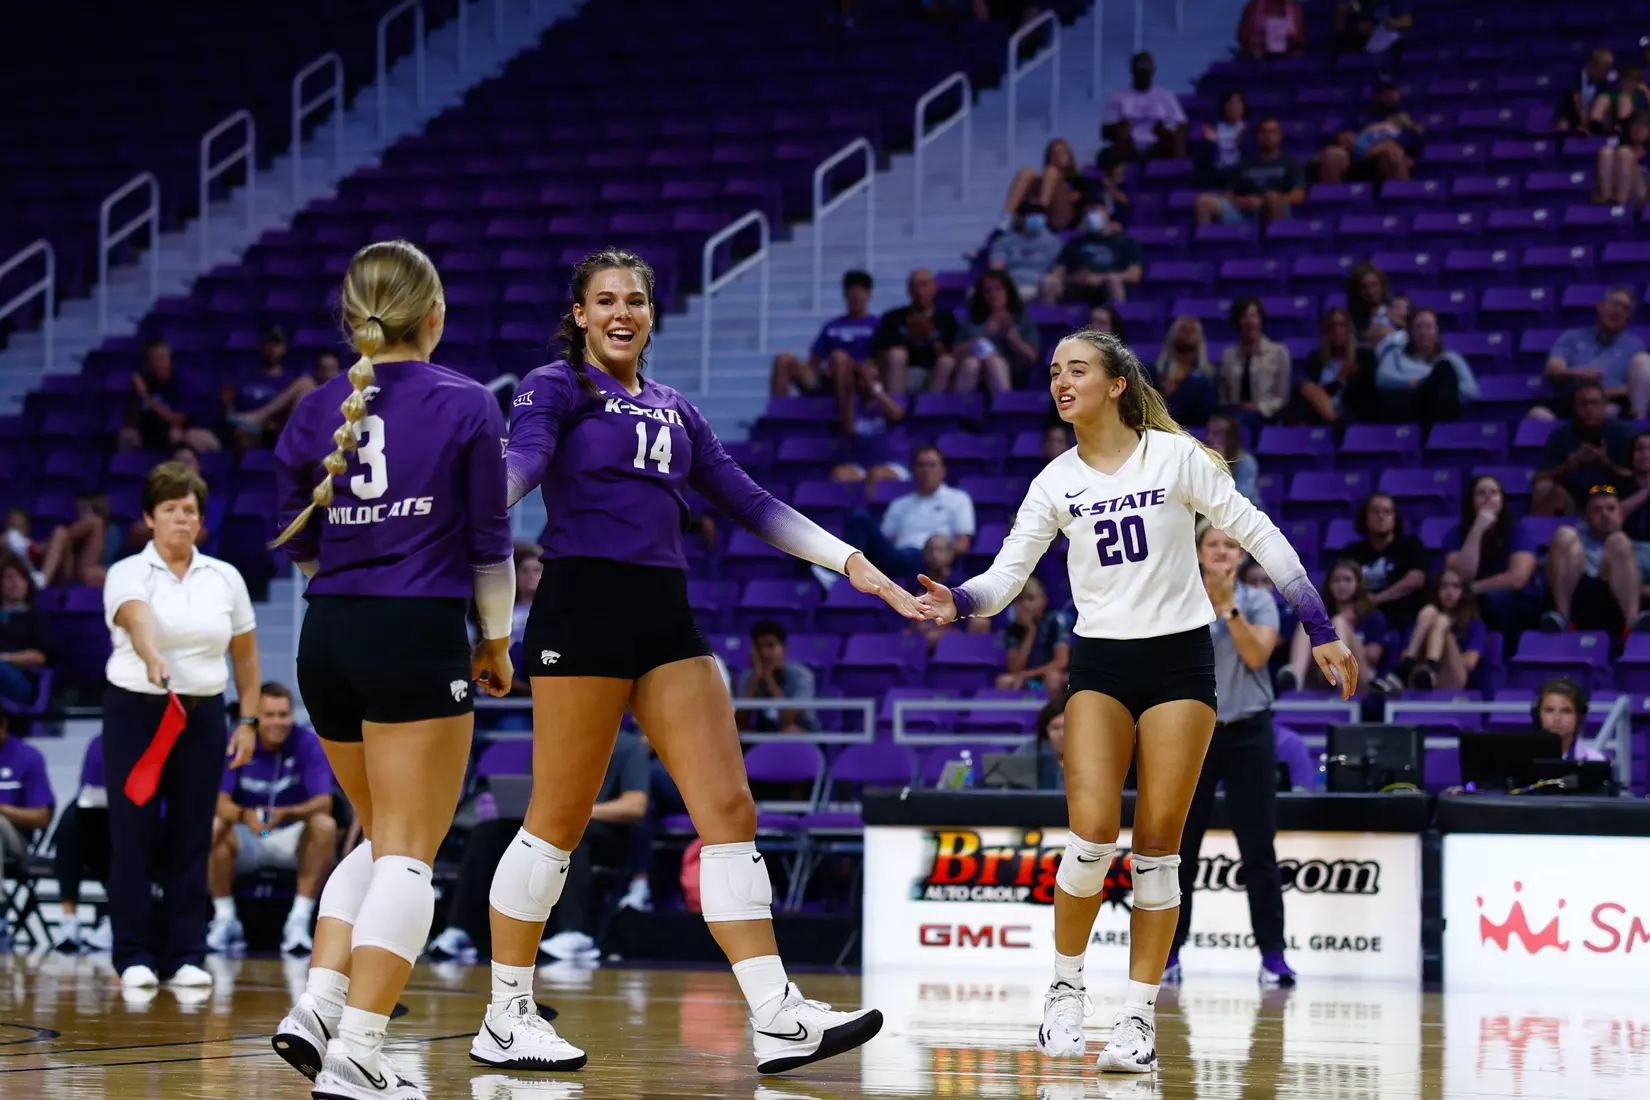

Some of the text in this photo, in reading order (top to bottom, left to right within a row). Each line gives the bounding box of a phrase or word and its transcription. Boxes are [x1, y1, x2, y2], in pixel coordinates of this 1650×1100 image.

[604, 398, 684, 427] K-STATE
[351, 414, 389, 500] 3
[633, 421, 672, 474] 14
[327, 496, 434, 525] WILDCATS
[1069, 488, 1166, 518] K-STATE
[1093, 514, 1149, 567] 20
[924, 885, 1031, 902] AUTO GROUP
[918, 923, 1032, 949] GMC
[1091, 932, 1130, 946] ARE
[1309, 935, 1382, 952] GRADE
